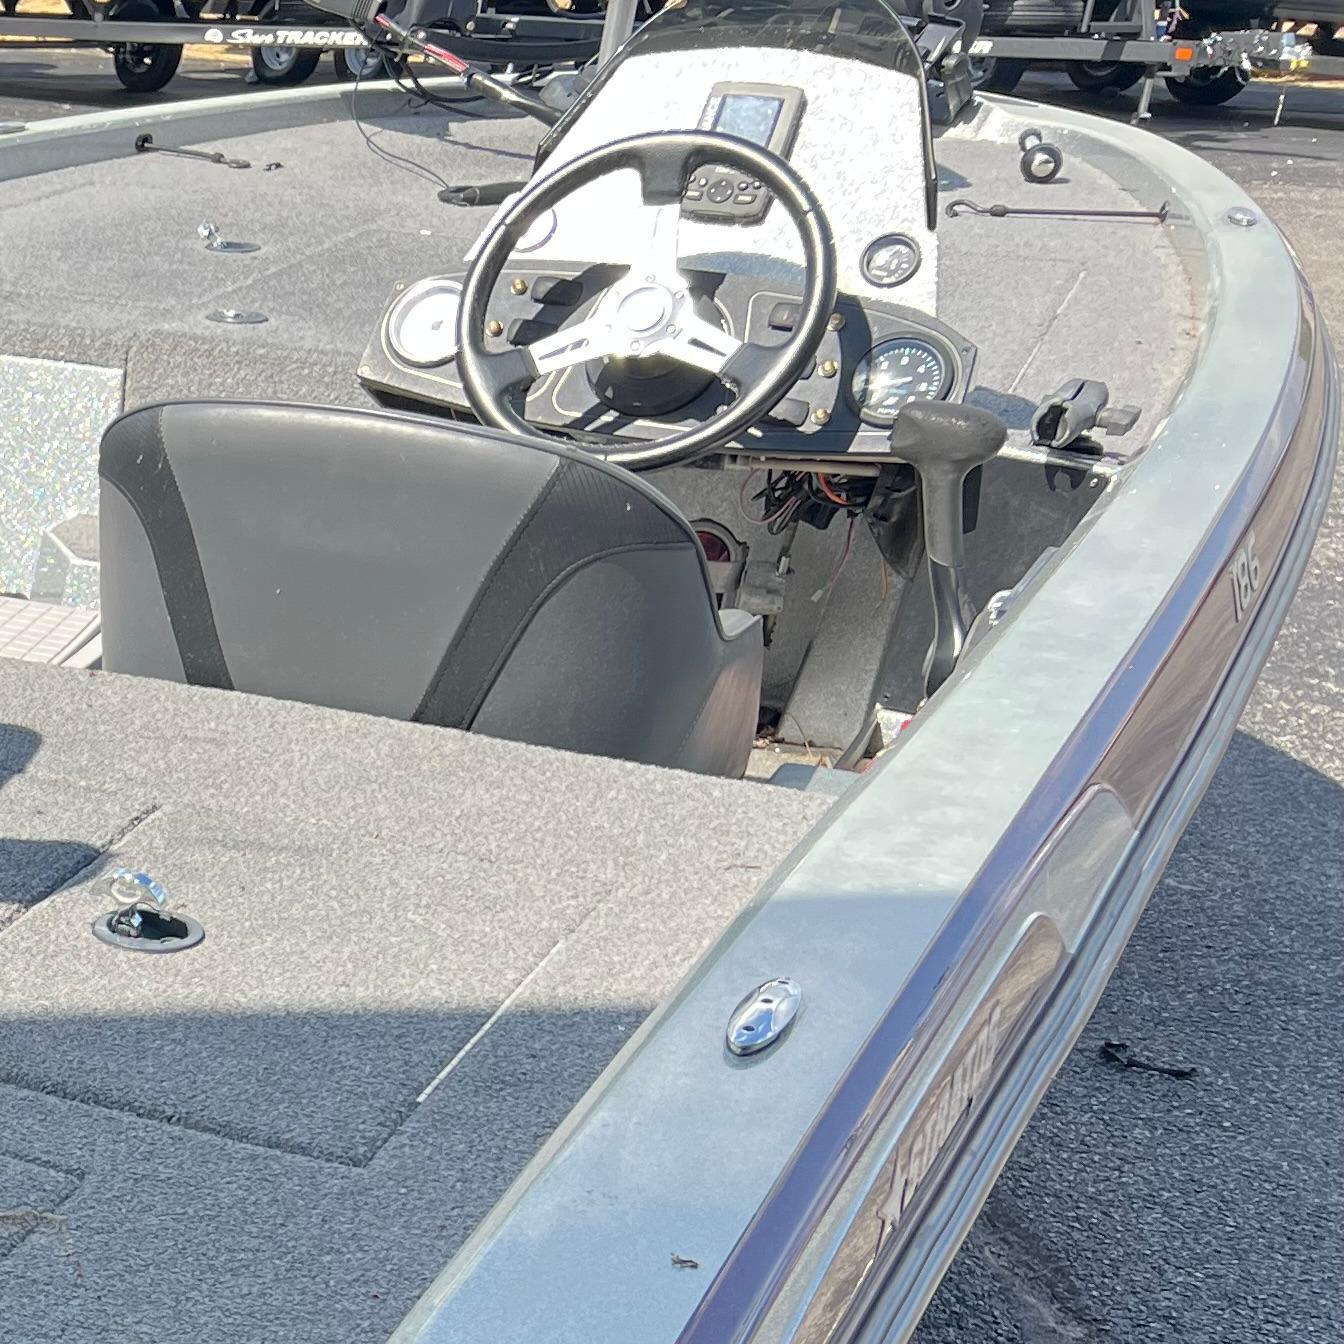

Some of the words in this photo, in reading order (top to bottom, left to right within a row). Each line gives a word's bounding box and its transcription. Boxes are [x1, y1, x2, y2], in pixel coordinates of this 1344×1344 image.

[226, 29, 275, 44] Sun
[276, 31, 369, 46] TRACKER
[1228, 529, 1261, 624] 186
